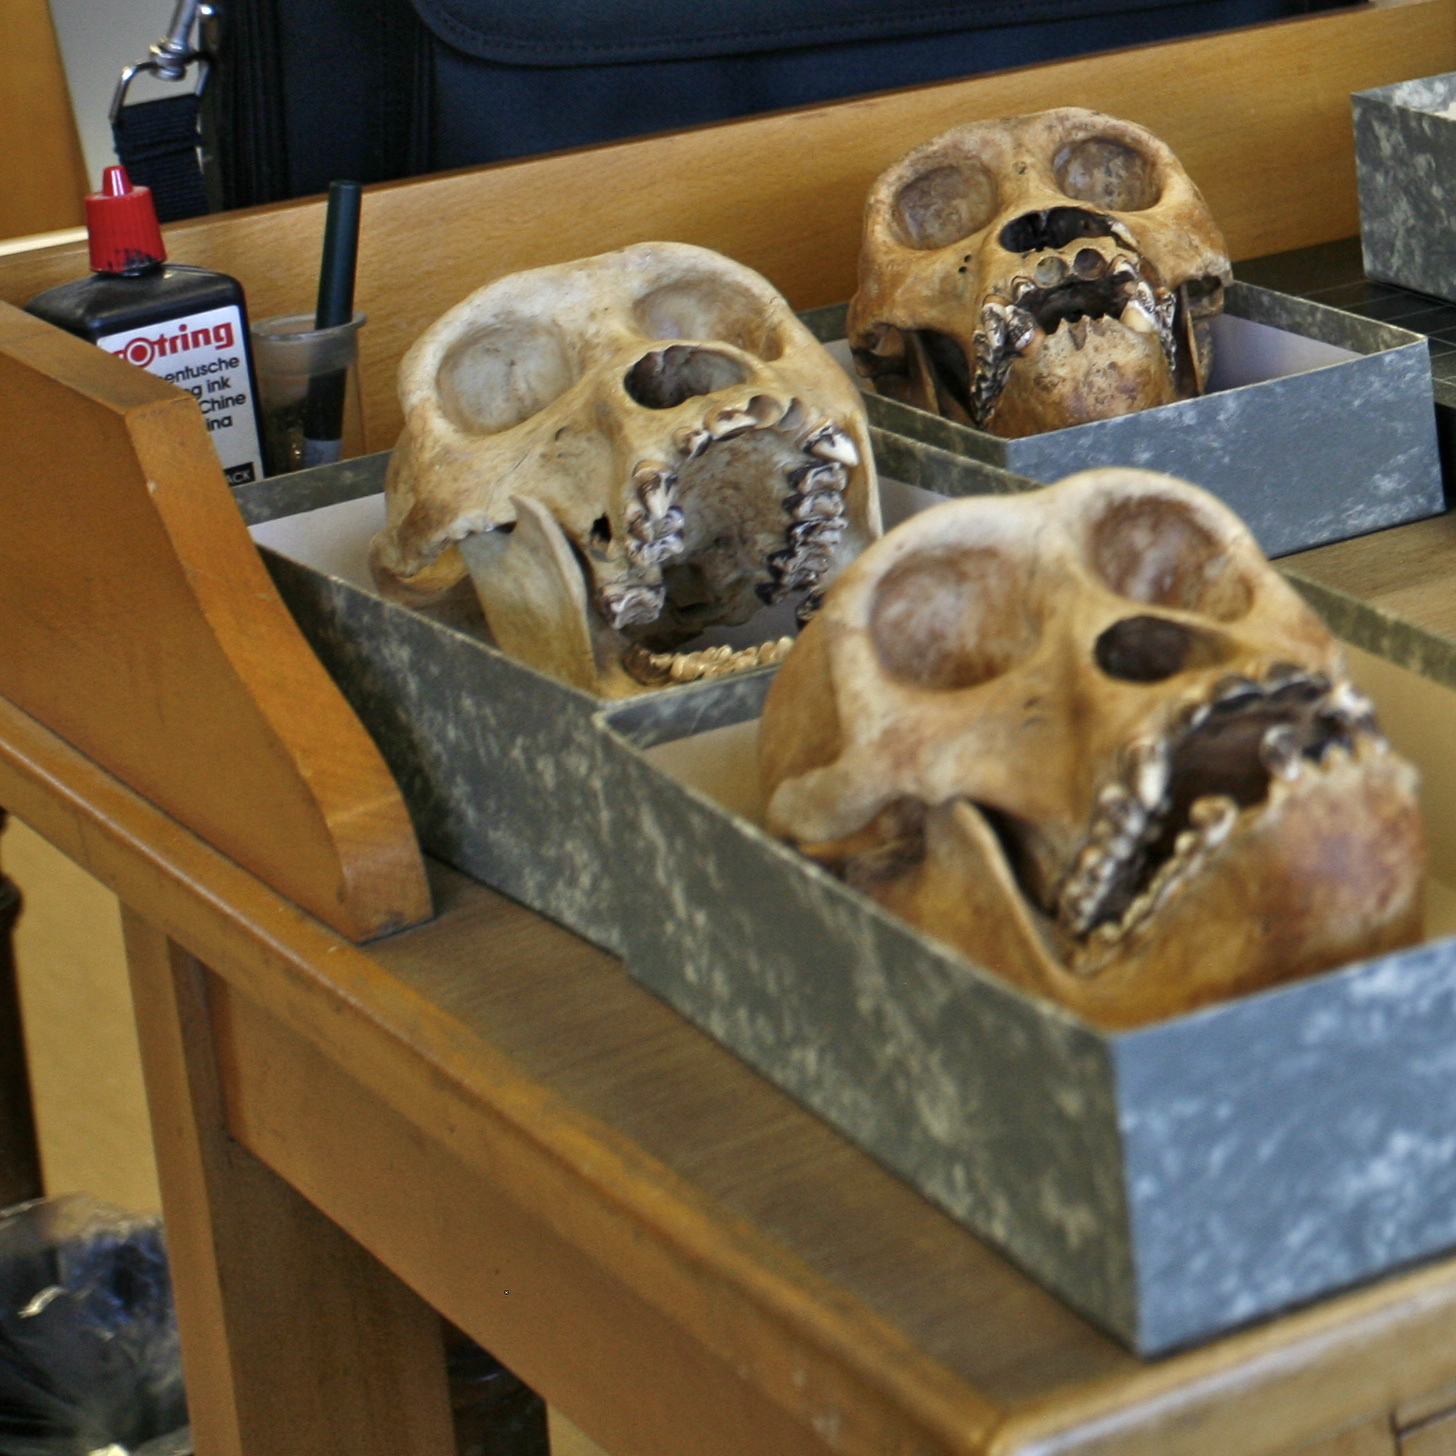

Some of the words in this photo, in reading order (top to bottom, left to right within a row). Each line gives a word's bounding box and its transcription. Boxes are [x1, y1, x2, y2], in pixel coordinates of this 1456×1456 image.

[159, 357, 240, 384] entusche
[206, 376, 231, 393] ink
[199, 393, 246, 414] Chine
[205, 415, 233, 431] ina
